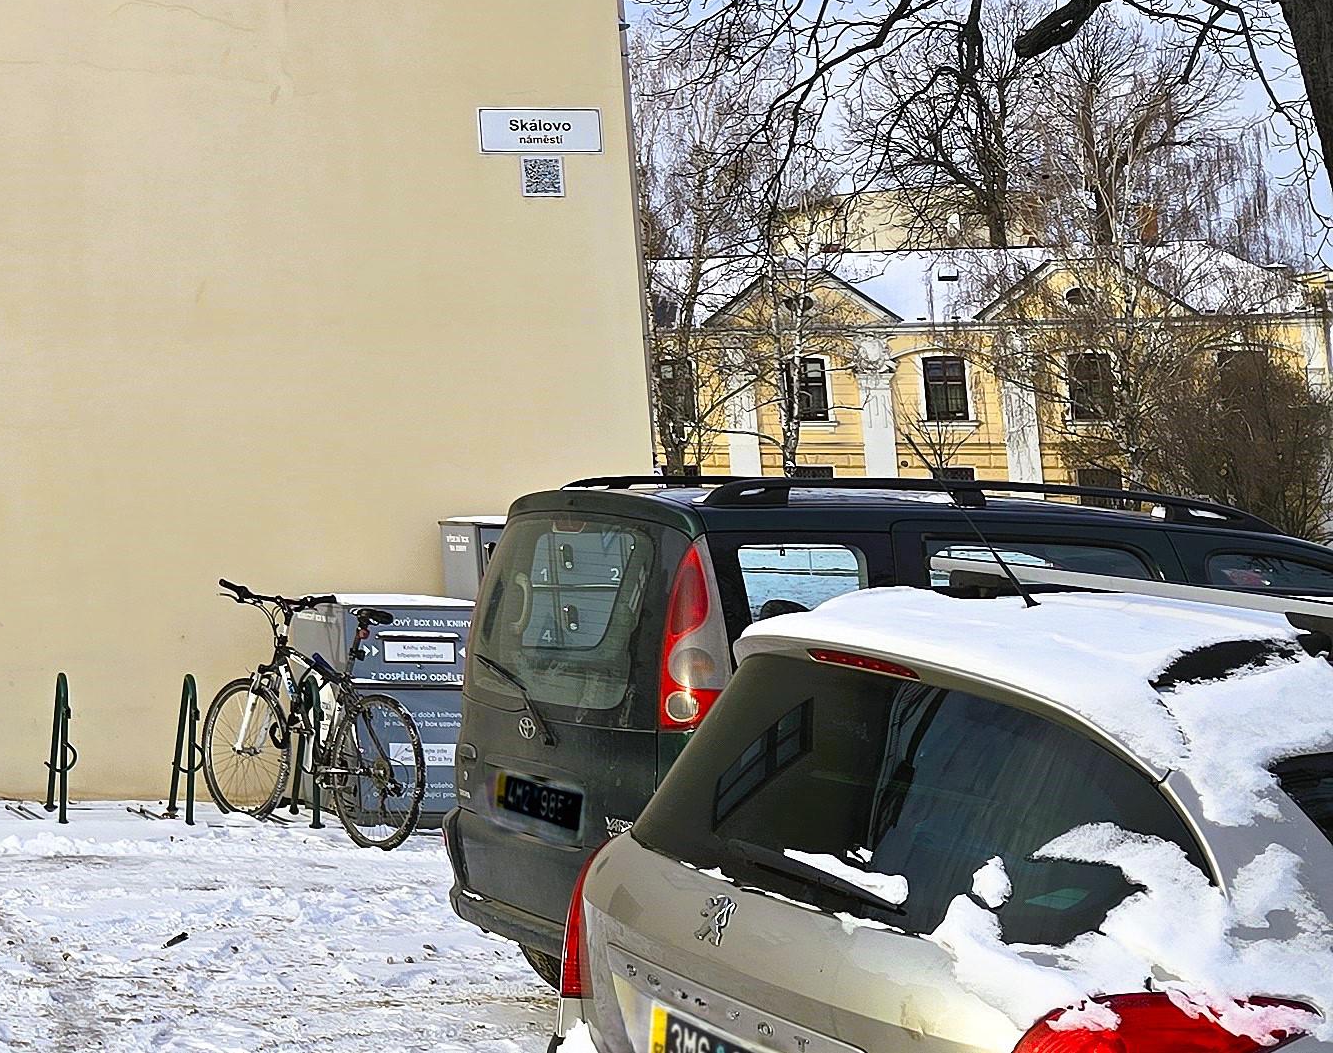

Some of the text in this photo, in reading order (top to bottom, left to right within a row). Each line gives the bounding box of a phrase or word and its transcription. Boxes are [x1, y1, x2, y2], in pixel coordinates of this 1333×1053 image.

[509, 118, 571, 132] Skálovo
[519, 134, 563, 144] náměstí
[414, 619, 431, 627] BOX
[433, 619, 445, 627] NA
[447, 619, 472, 628] KNIHY
[379, 672, 428, 681] DOSPĚLÉHO
